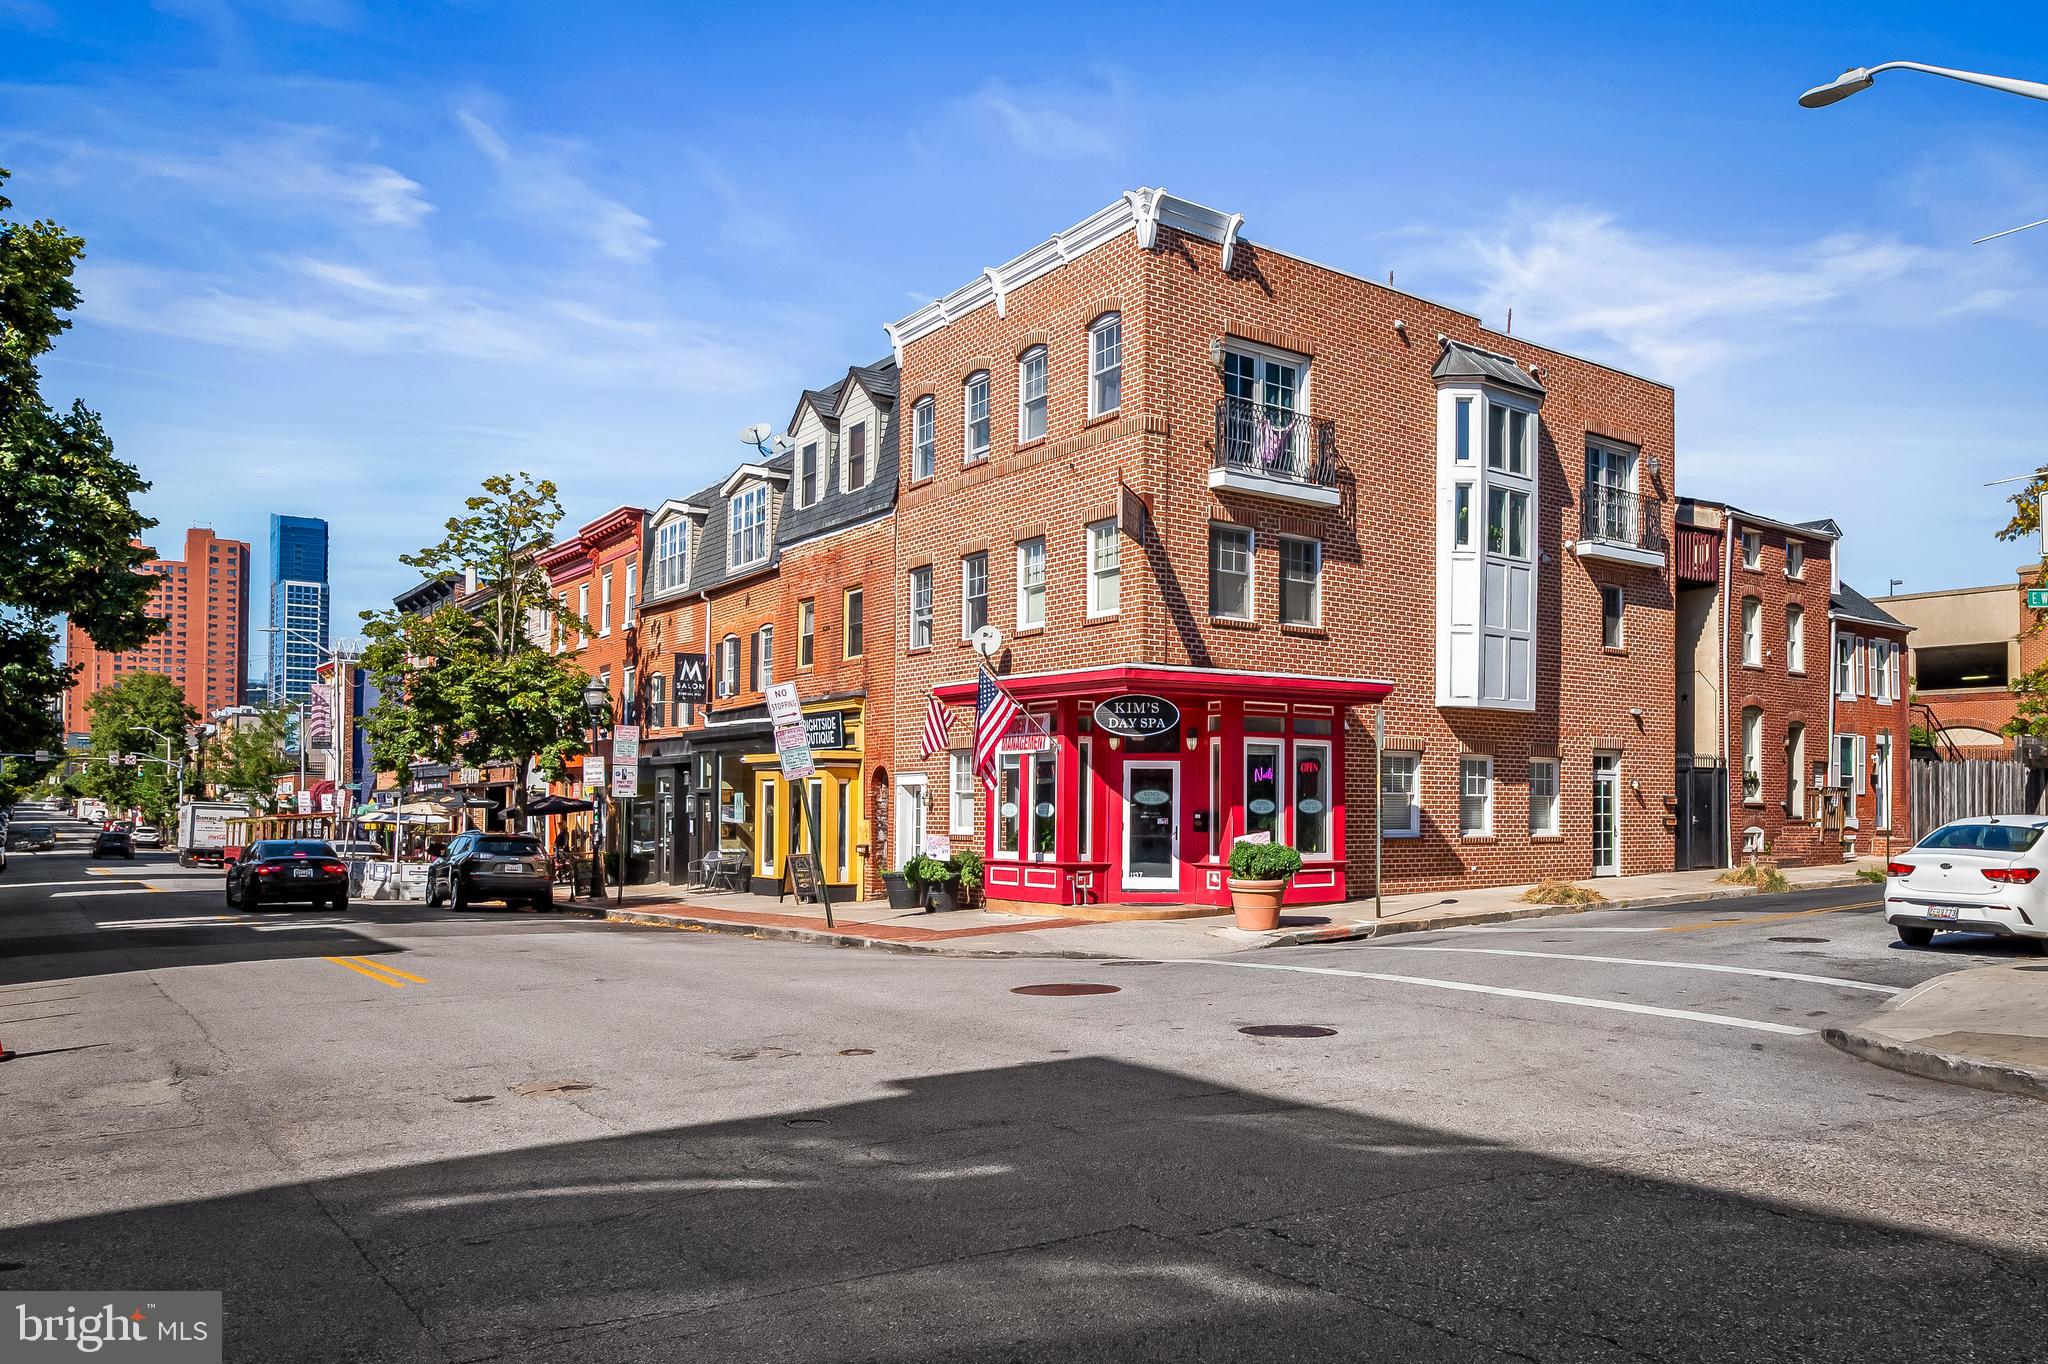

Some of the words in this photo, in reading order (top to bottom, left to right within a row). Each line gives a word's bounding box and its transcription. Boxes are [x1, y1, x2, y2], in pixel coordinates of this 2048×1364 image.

[680, 660, 702, 681] M
[676, 682, 705, 690] SALON
[774, 689, 788, 699] NO
[771, 699, 797, 712] STOPPING
[1114, 702, 1160, 714] KIM'S
[1108, 718, 1137, 729] DAY
[1140, 718, 1166, 729] SPA
[1002, 735, 1046, 751] MANAGEMENT
[1300, 762, 1319, 773] OPEN
